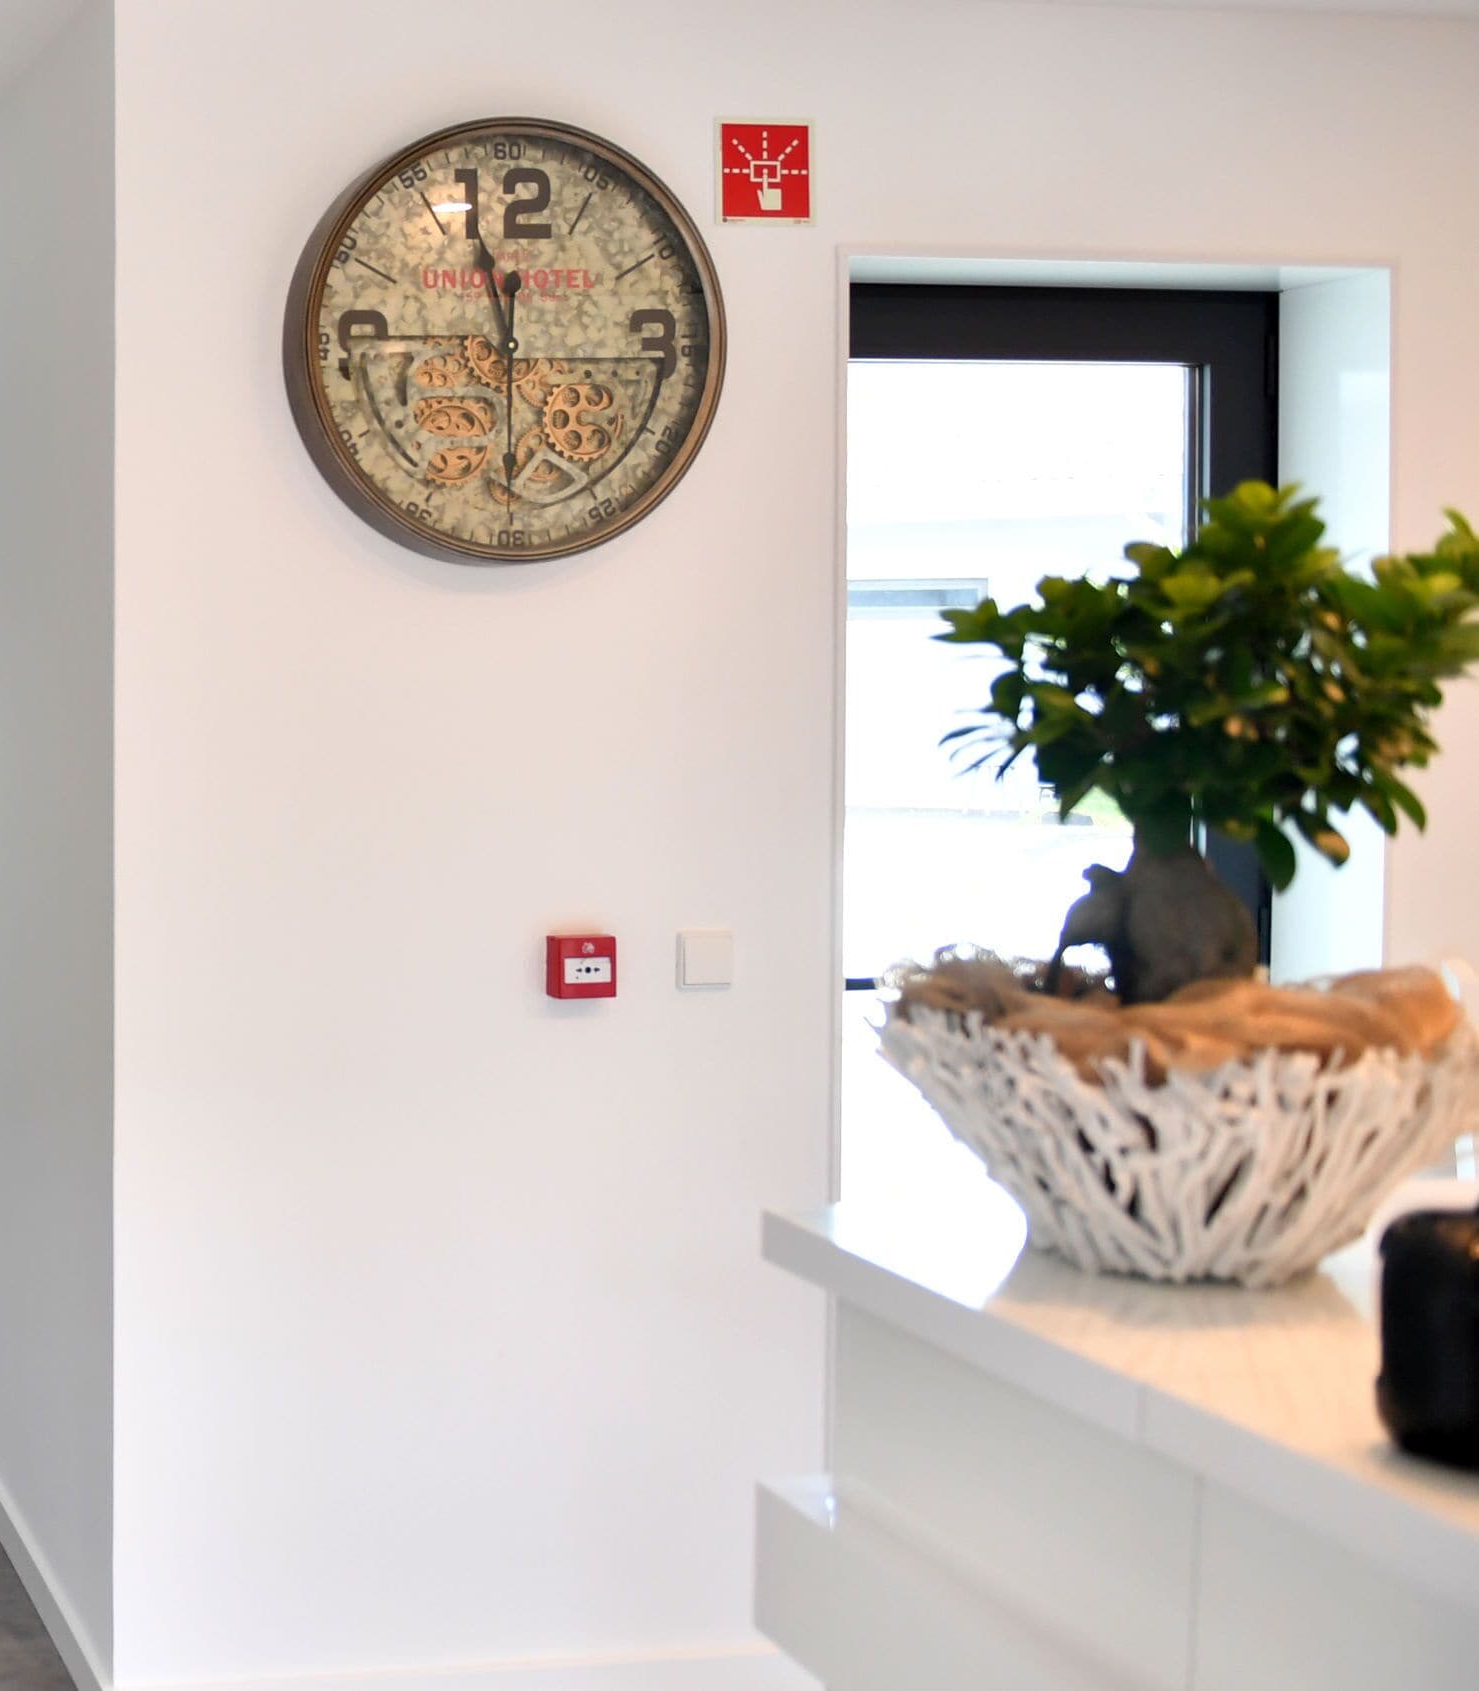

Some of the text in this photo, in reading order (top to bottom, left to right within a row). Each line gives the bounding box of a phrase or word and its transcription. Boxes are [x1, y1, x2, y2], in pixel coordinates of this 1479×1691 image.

[494, 142, 521, 160] 60
[455, 168, 552, 240] 12
[629, 309, 677, 379] 3
[497, 530, 526, 548] 30
